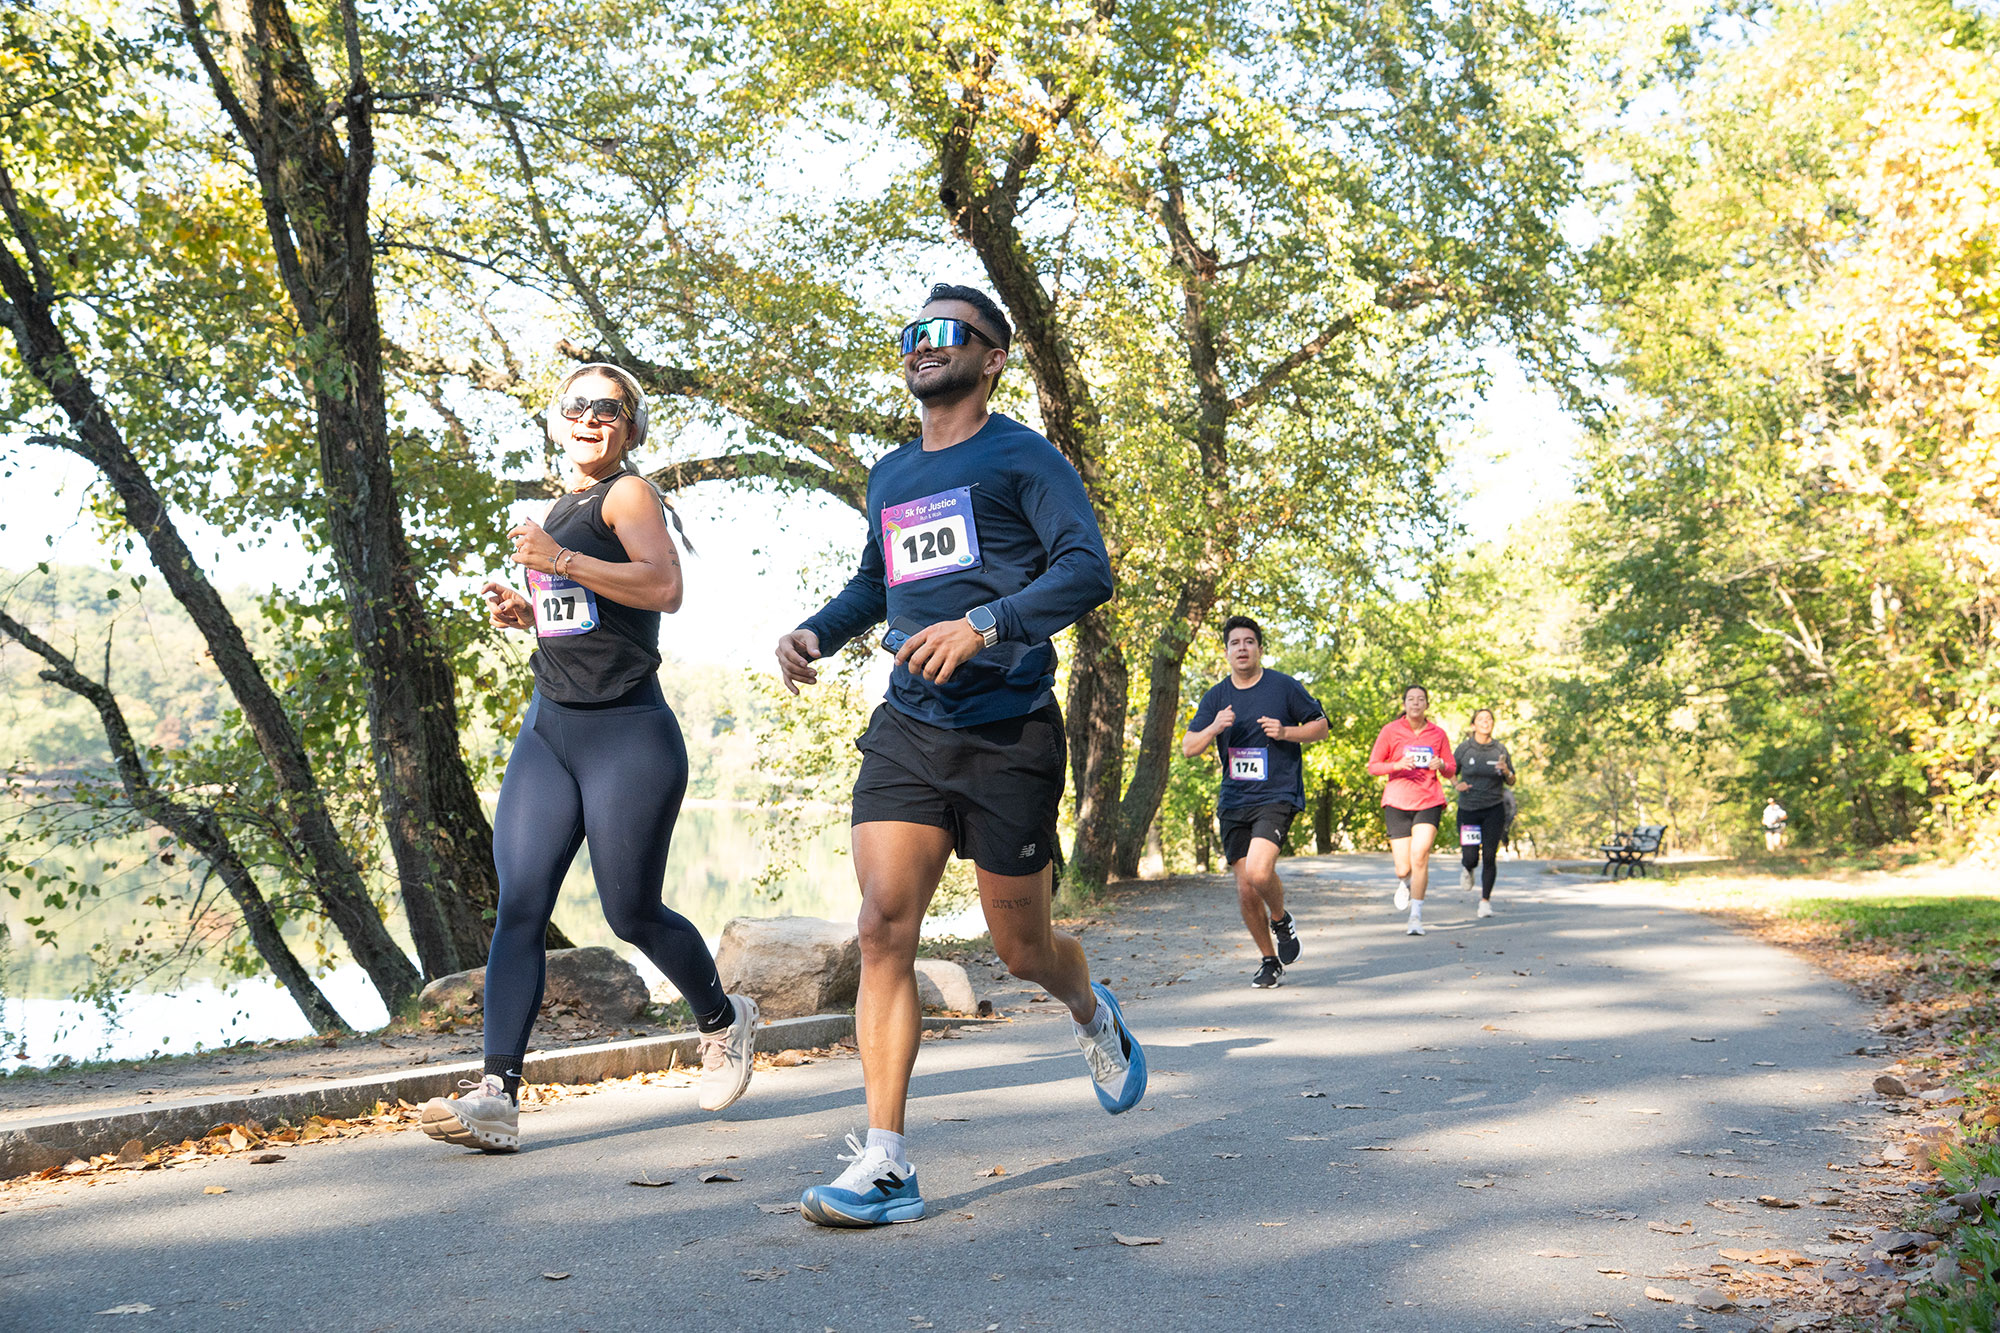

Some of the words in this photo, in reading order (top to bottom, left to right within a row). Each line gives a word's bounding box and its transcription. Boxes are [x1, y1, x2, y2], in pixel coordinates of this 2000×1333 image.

[905, 508, 914, 518] 5k
[916, 505, 927, 515] for
[928, 498, 957, 512] Justice
[902, 527, 956, 563] 120
[543, 596, 575, 621] 127
[1236, 762, 1258, 773] 174
